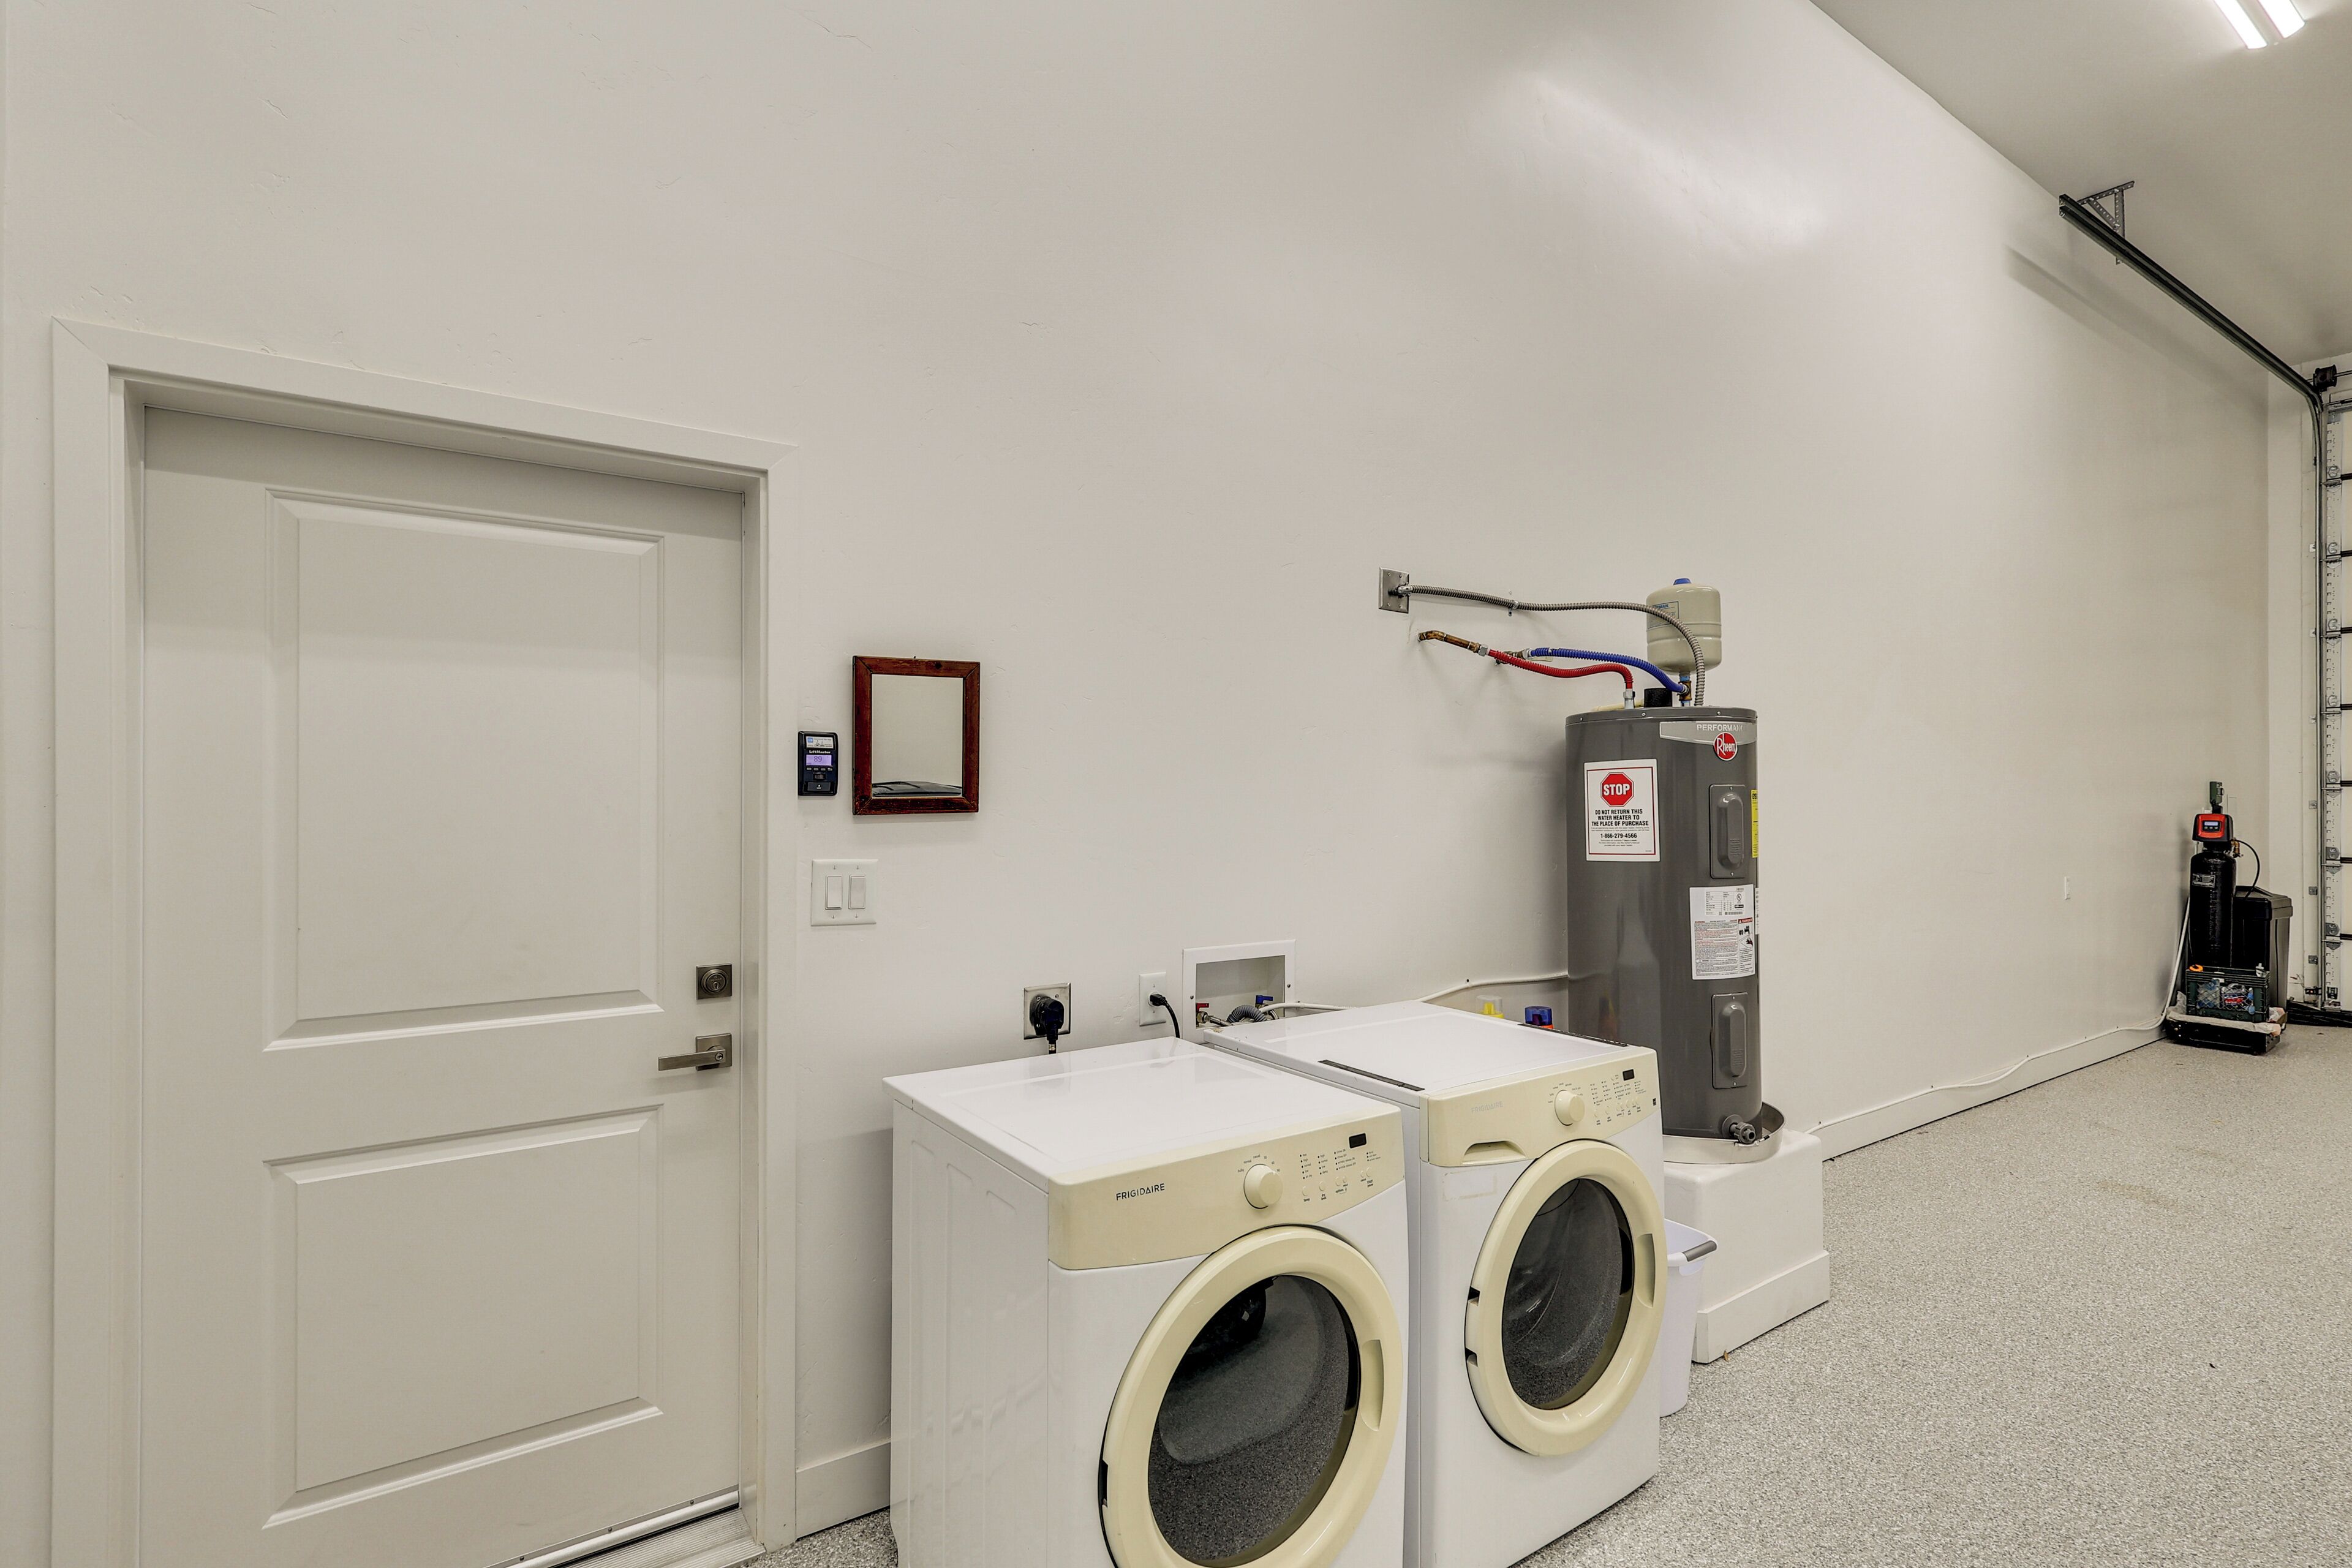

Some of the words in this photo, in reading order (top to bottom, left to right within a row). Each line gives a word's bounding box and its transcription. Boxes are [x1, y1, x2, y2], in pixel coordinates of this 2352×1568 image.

[1717, 733, 1735, 755] Rheem
[1604, 783, 1630, 796] STOP
[1116, 1183, 1165, 1200] FRIGIDAIRE
